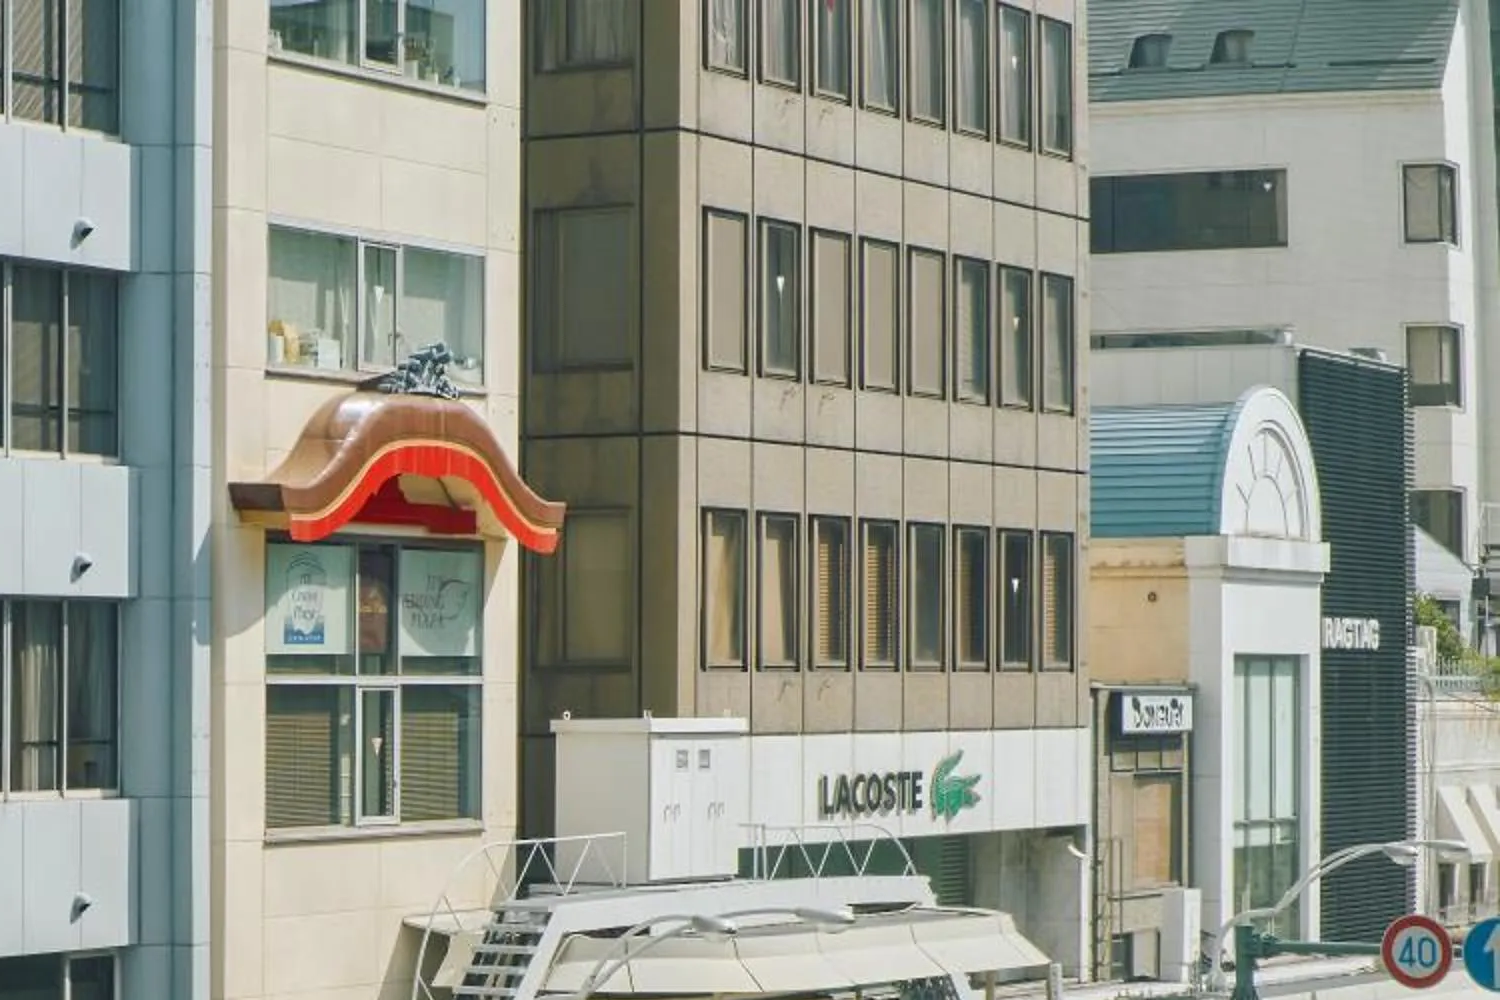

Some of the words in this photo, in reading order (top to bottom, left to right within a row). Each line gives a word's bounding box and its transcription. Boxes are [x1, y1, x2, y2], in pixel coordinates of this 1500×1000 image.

[1323, 617, 1380, 650] RAGTAG
[821, 770, 923, 816] LACOSTE
[1398, 936, 1437, 968] 40
